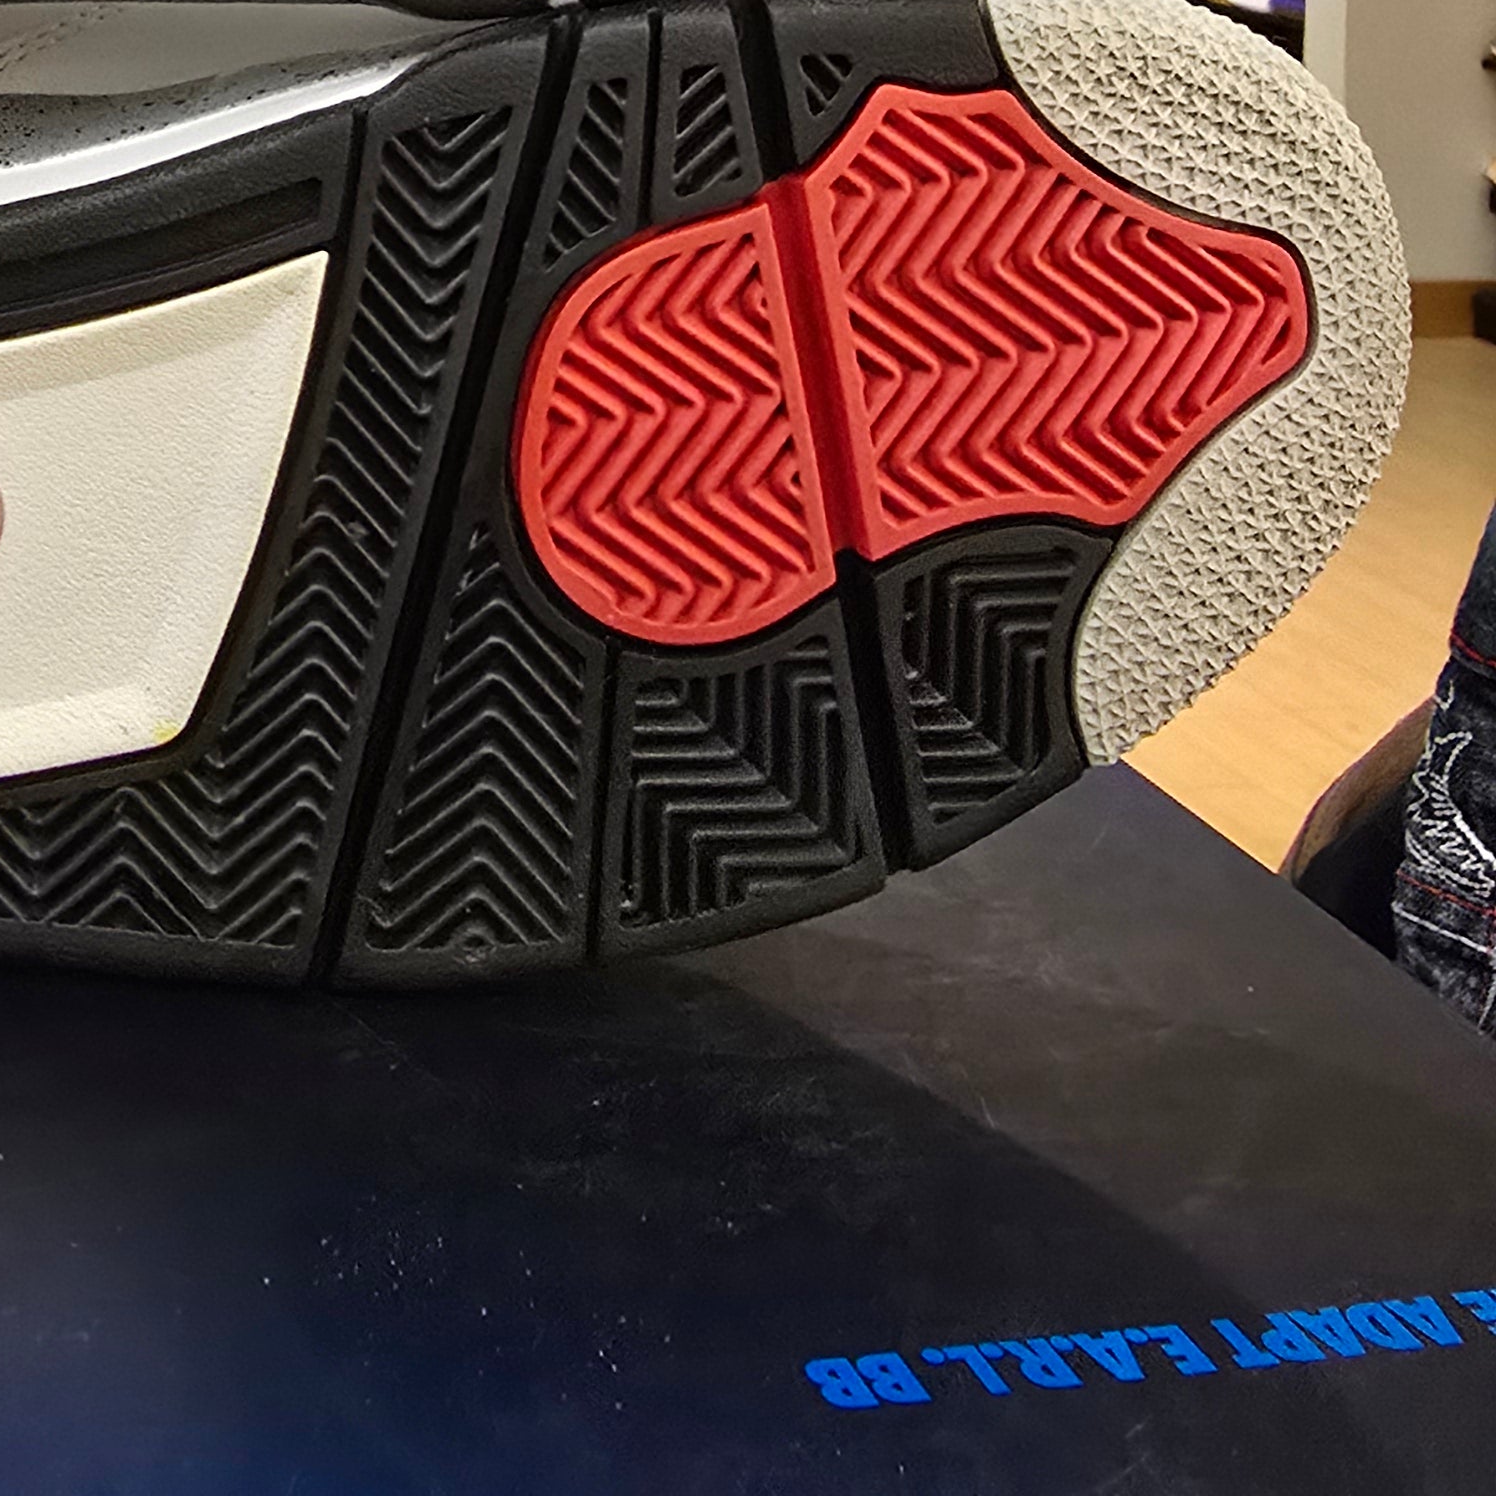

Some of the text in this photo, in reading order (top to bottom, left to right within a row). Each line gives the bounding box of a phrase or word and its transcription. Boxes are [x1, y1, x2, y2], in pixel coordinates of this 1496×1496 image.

[920, 1324, 1218, 1395] E.A.R.L.
[1211, 1295, 1464, 1369] ADAPT
[804, 1352, 932, 1409] BB
